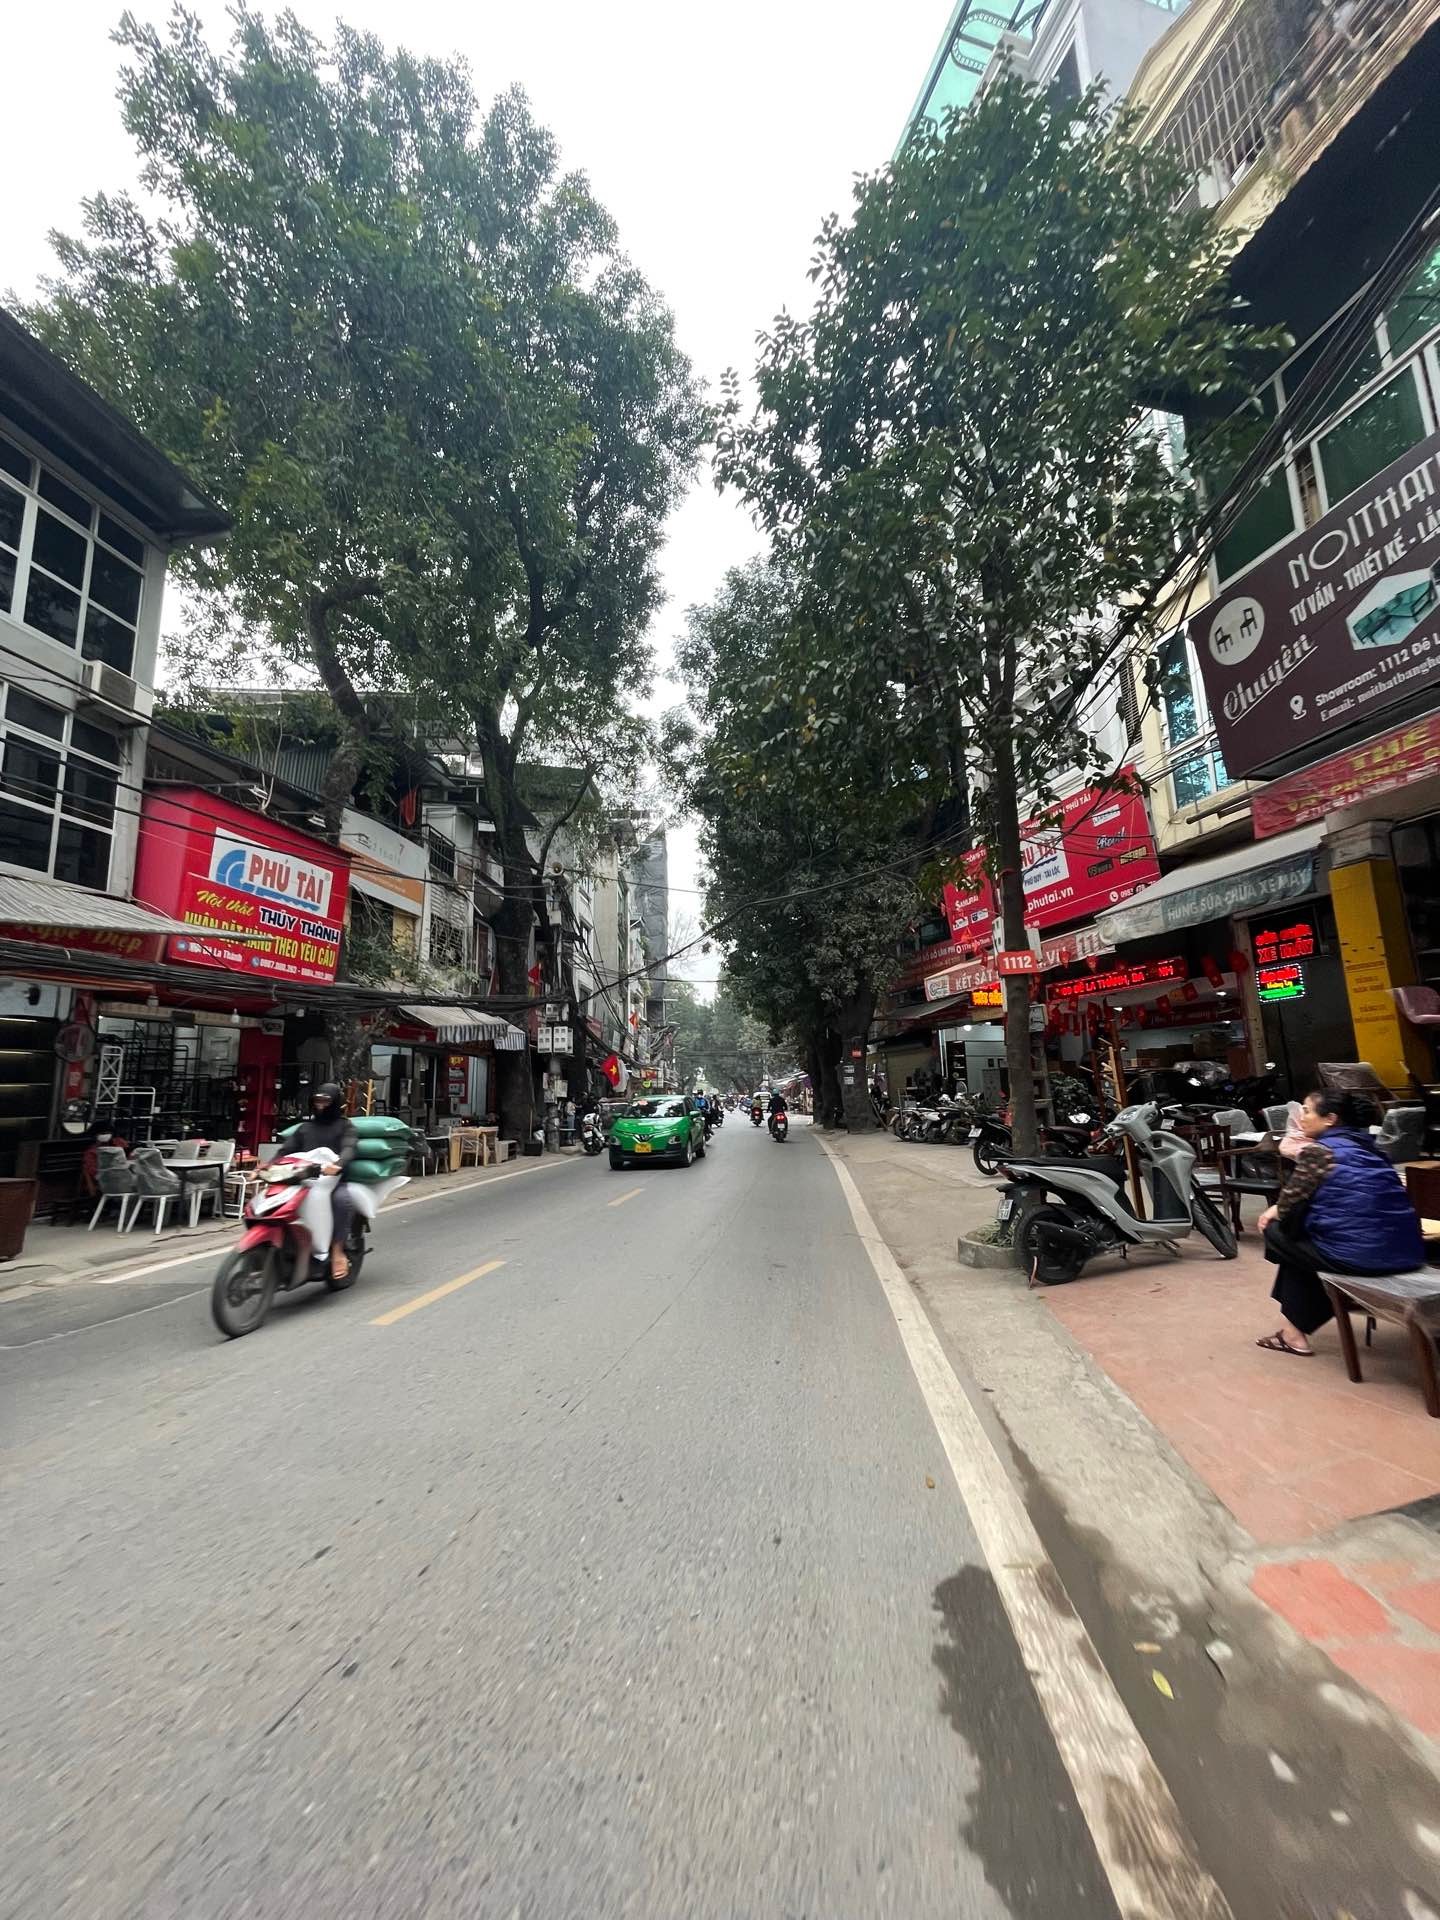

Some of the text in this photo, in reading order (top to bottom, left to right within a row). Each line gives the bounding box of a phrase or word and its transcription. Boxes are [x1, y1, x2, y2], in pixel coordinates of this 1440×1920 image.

[1288, 451, 1440, 589] NOITHAT
[1384, 528, 1408, 565] KẾ
[1223, 634, 1315, 720] Chuyên
[1315, 668, 1378, 706] Showroom:
[1378, 649, 1410, 673] 1112
[1411, 637, 1432, 656] Đê
[249, 854, 291, 892] PHÚ
[297, 869, 324, 904] TÀI
[274, 935, 299, 959] THEO
[1003, 955, 1032, 970] 1112
